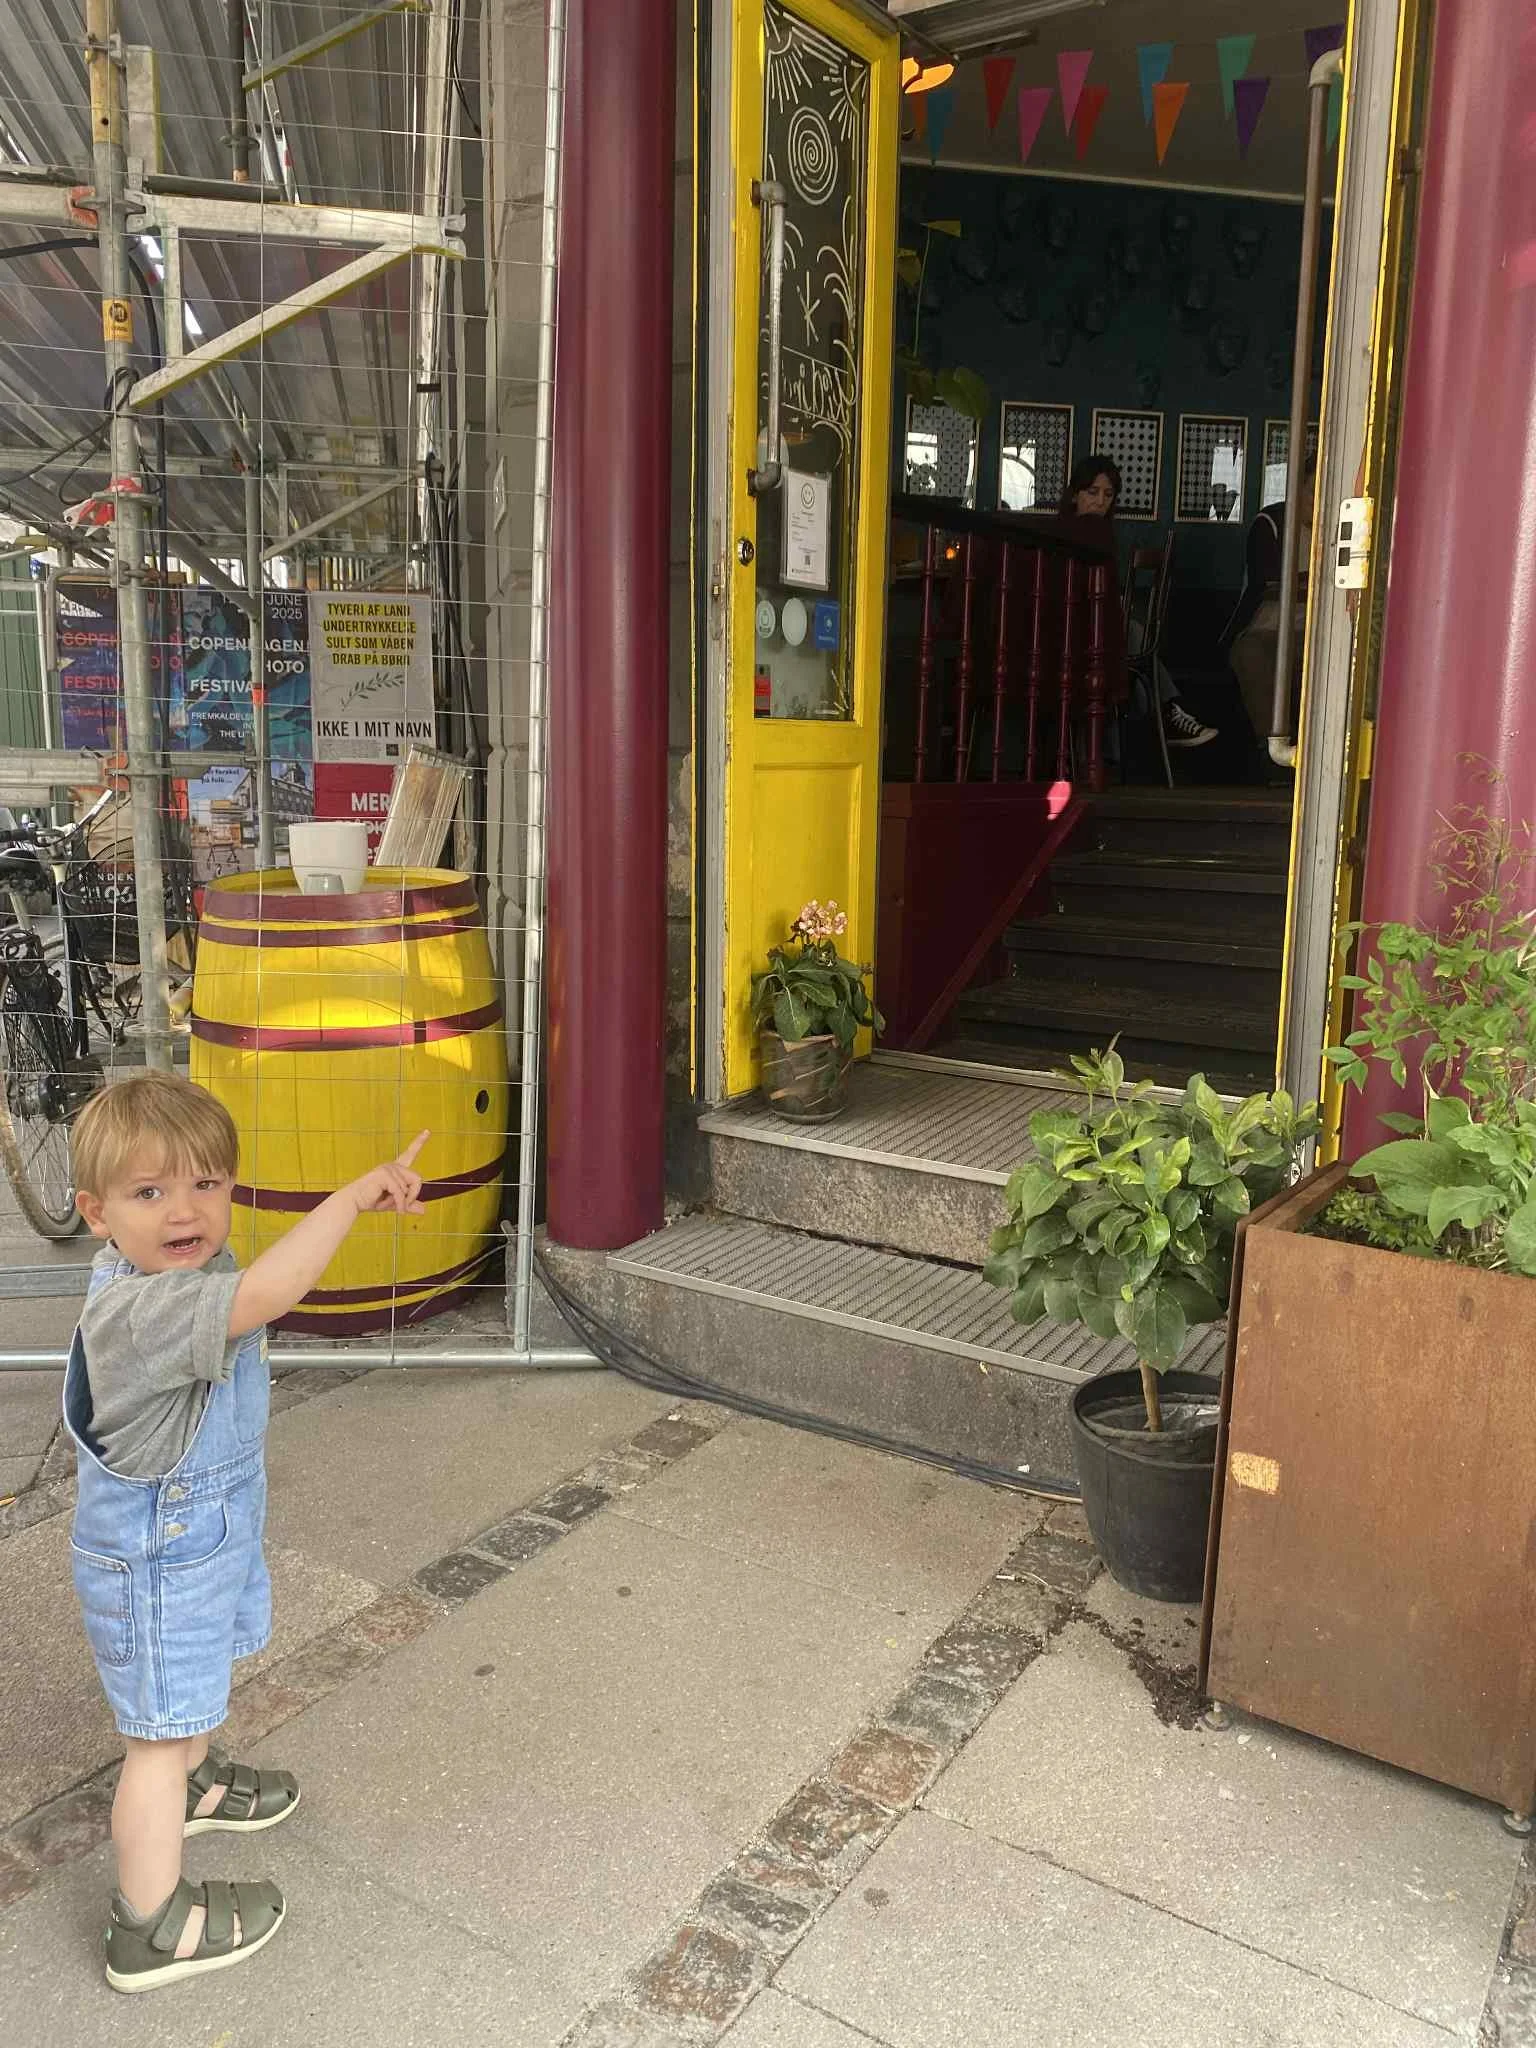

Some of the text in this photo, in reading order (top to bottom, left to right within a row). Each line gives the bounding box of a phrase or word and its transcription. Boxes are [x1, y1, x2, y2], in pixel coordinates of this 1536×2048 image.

[266, 594, 303, 606] JUNE
[271, 607, 303, 619] 2025
[327, 604, 364, 617] TYVERI
[367, 605, 382, 617] AF
[326, 637, 352, 649] SULT
[354, 637, 378, 649] SOM
[332, 653, 361, 665] DRAB
[365, 650, 378, 665] PÅ
[317, 721, 432, 738] IKKE I MIT NAVN
